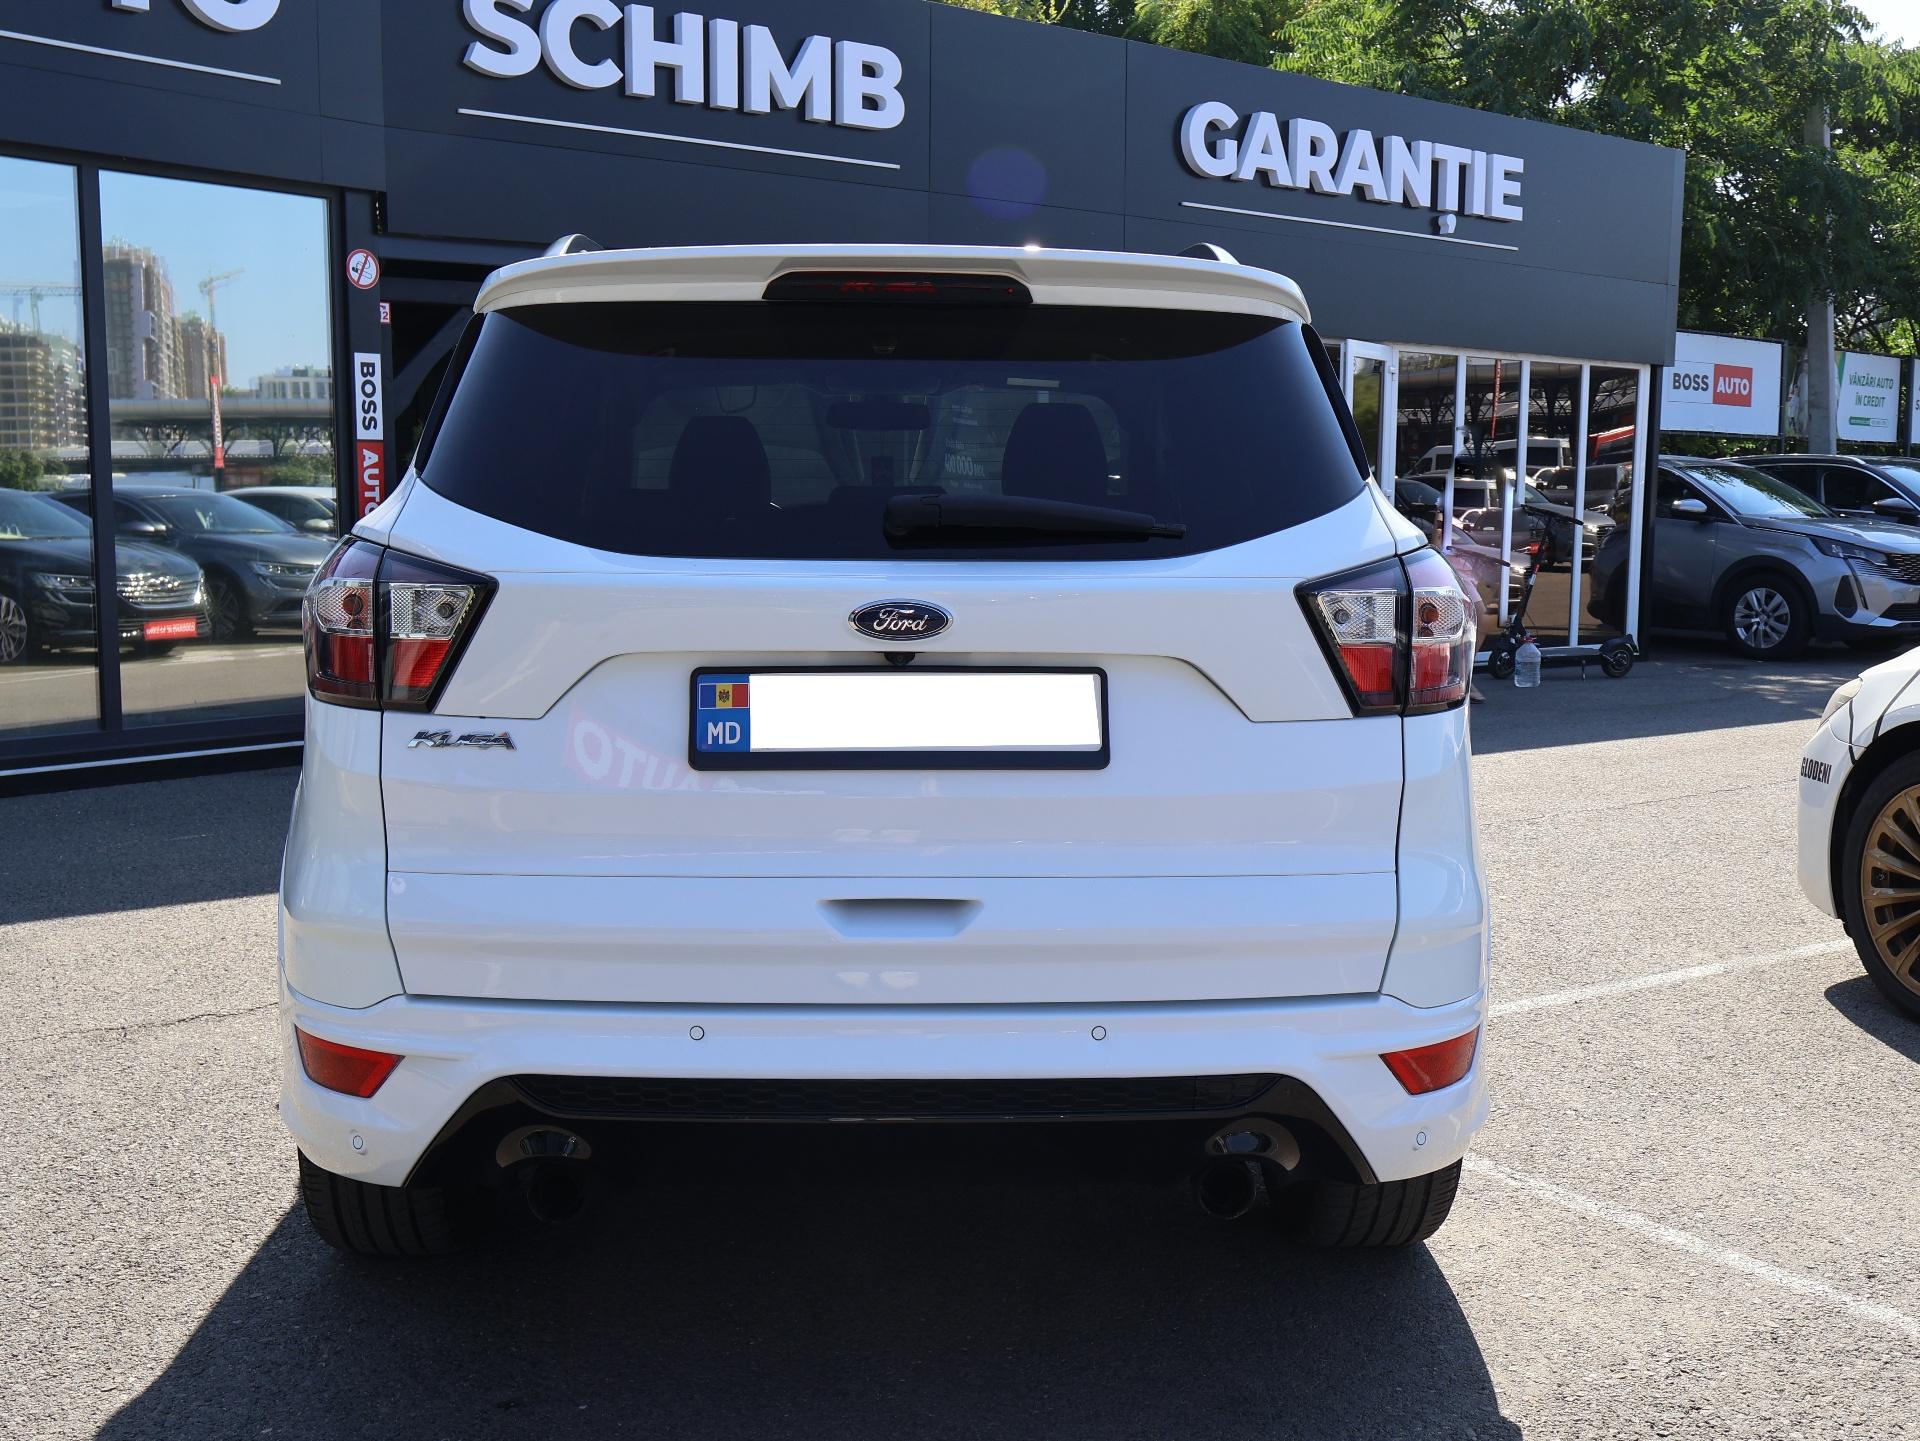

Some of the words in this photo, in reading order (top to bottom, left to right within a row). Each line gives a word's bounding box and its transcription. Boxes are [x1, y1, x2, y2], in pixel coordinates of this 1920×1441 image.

[462, 0, 905, 131] SCHIMB
[1180, 101, 1524, 235] GARANȚIE
[1673, 372, 1709, 392] BOSS
[1716, 376, 1750, 396] AUTO
[1876, 377, 1894, 389] AUTO
[360, 362, 377, 431] BOSS
[1863, 395, 1886, 408] CREDIT
[873, 607, 928, 631] Ford
[707, 722, 741, 745] MD
[1800, 757, 1832, 784] GLODENI
